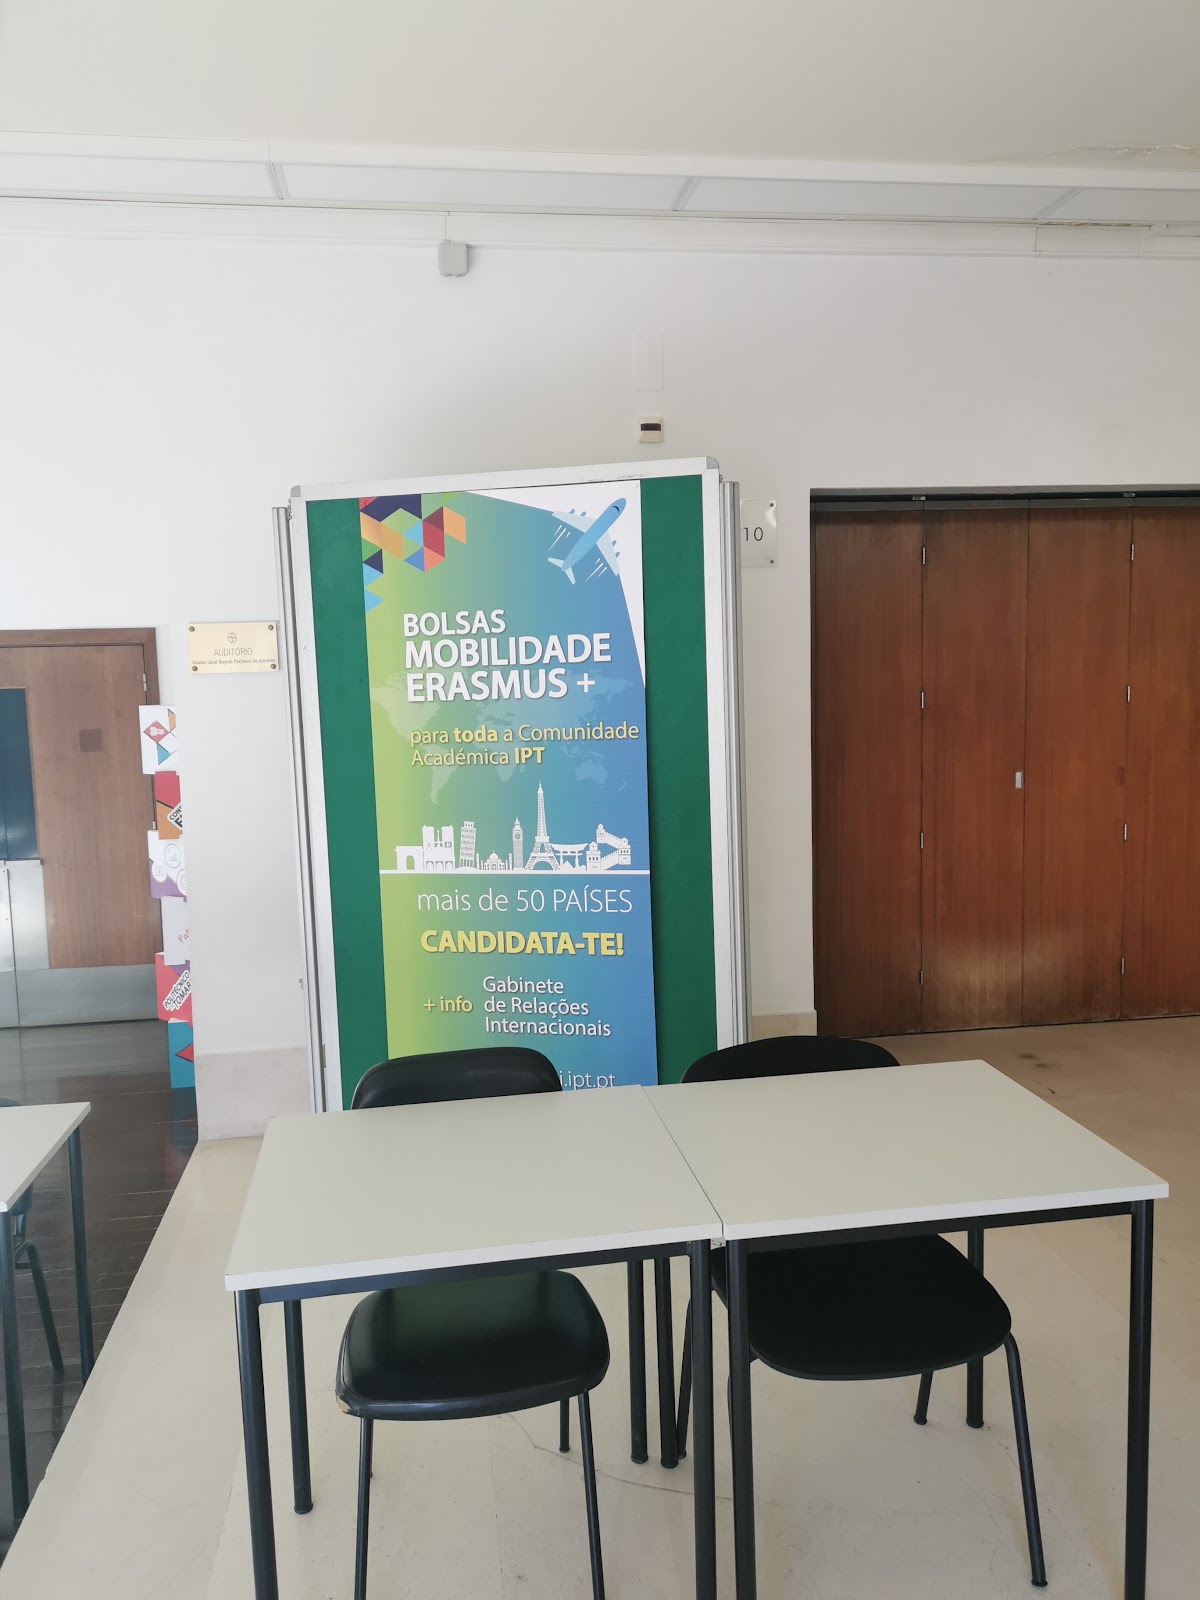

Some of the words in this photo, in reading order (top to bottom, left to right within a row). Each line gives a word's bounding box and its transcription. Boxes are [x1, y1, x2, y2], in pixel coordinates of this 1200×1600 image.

[744, 526, 764, 542] 10
[403, 609, 507, 637] BOLSAS
[213, 647, 253, 657] AUDITÓRIO
[404, 632, 612, 669] MOBILIDADE
[406, 667, 569, 702] ERASMUS
[576, 672, 596, 693] +
[409, 727, 449, 748] para
[453, 724, 499, 744] toda
[502, 728, 513, 743] a
[518, 720, 640, 742] Comunidade
[411, 748, 510, 766] Académica
[514, 746, 546, 765] IPT
[417, 889, 471, 911] mais
[478, 887, 509, 912] de
[516, 889, 545, 912] 50
[552, 884, 633, 913] PAÍSES
[420, 929, 624, 956] CANDIDATA-TE!
[173, 981, 192, 1008] TOMAR
[482, 976, 564, 994] Gabinete
[423, 999, 436, 1012] +
[439, 996, 473, 1013] info
[484, 997, 506, 1013] de
[511, 998, 589, 1018] Relações
[485, 1017, 611, 1037] Internacionais
